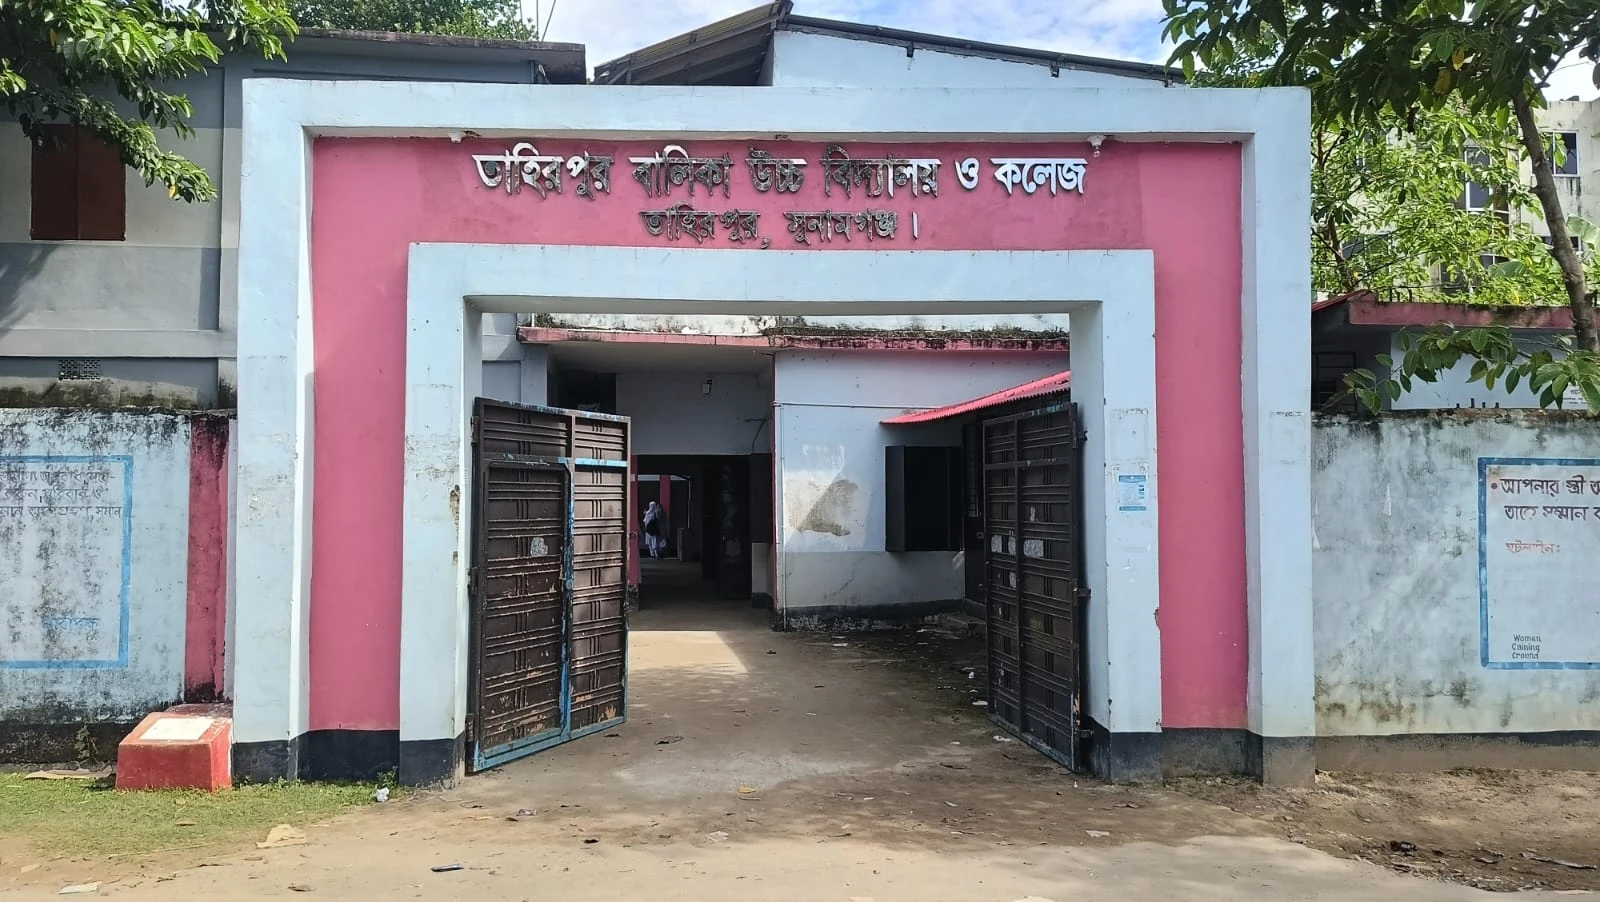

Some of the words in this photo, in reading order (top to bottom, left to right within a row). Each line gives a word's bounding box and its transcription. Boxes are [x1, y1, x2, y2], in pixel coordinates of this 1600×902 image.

[471, 142, 614, 199] তাহিরপুর
[628, 144, 735, 198] বালিকা
[745, 146, 808, 193] উচ্চ
[820, 144, 943, 198] বিদ্যালয়
[954, 157, 981, 191] ও
[990, 157, 1089, 196] কলেজ
[1500, 478, 1560, 497] আপনার
[1566, 474, 1587, 495] স্ত্রী
[1542, 505, 1590, 521] সম্মান
